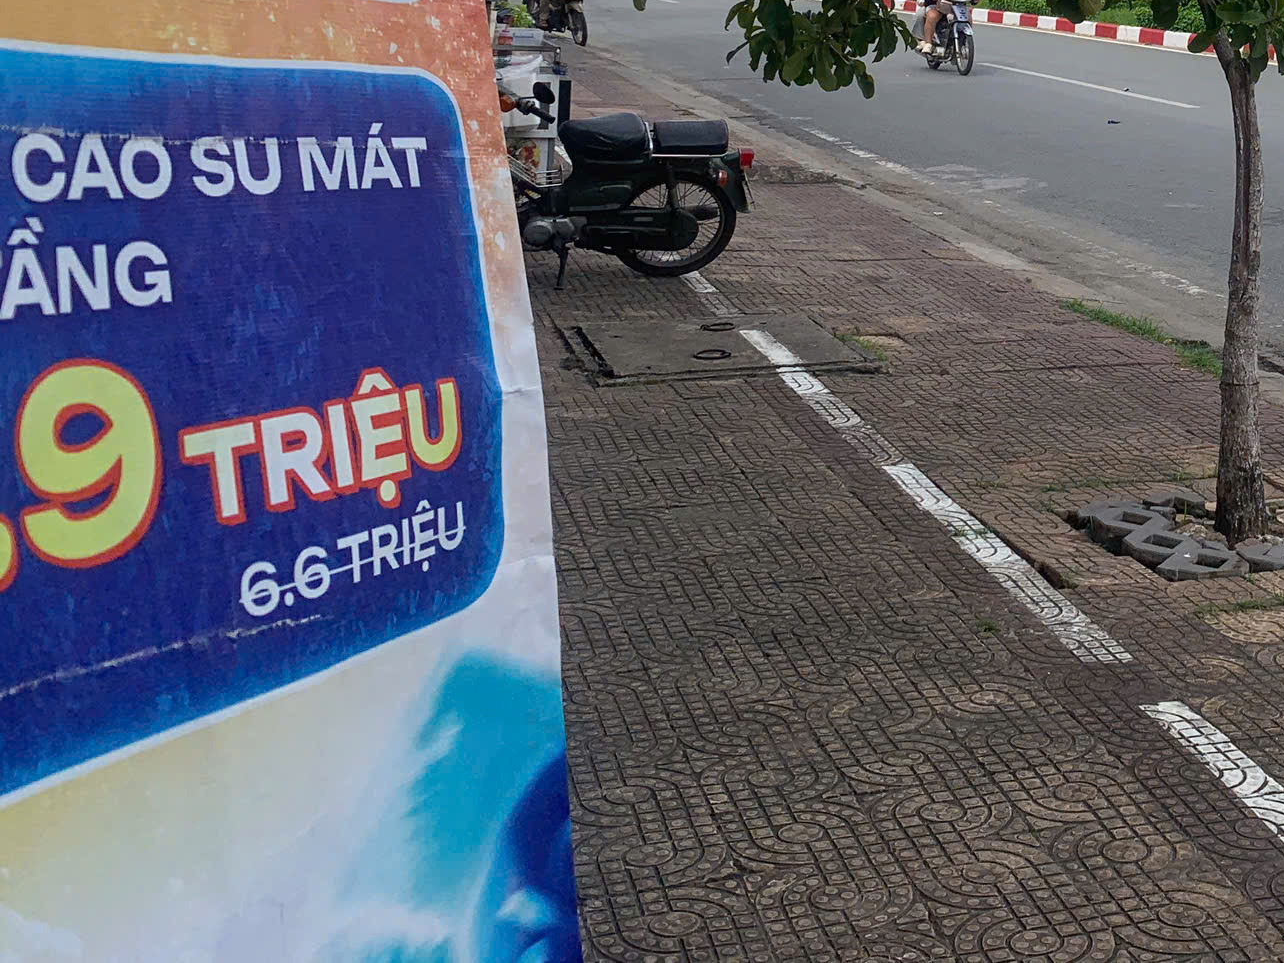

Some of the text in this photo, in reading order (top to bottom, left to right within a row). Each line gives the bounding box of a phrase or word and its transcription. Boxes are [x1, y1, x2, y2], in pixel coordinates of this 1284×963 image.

[11, 122, 428, 203] CAO SU MÁT
[0, 217, 173, 320] ẦNG
[178, 365, 463, 526] TRIỆU
[239, 500, 467, 617] 6.6 TRIỆU
